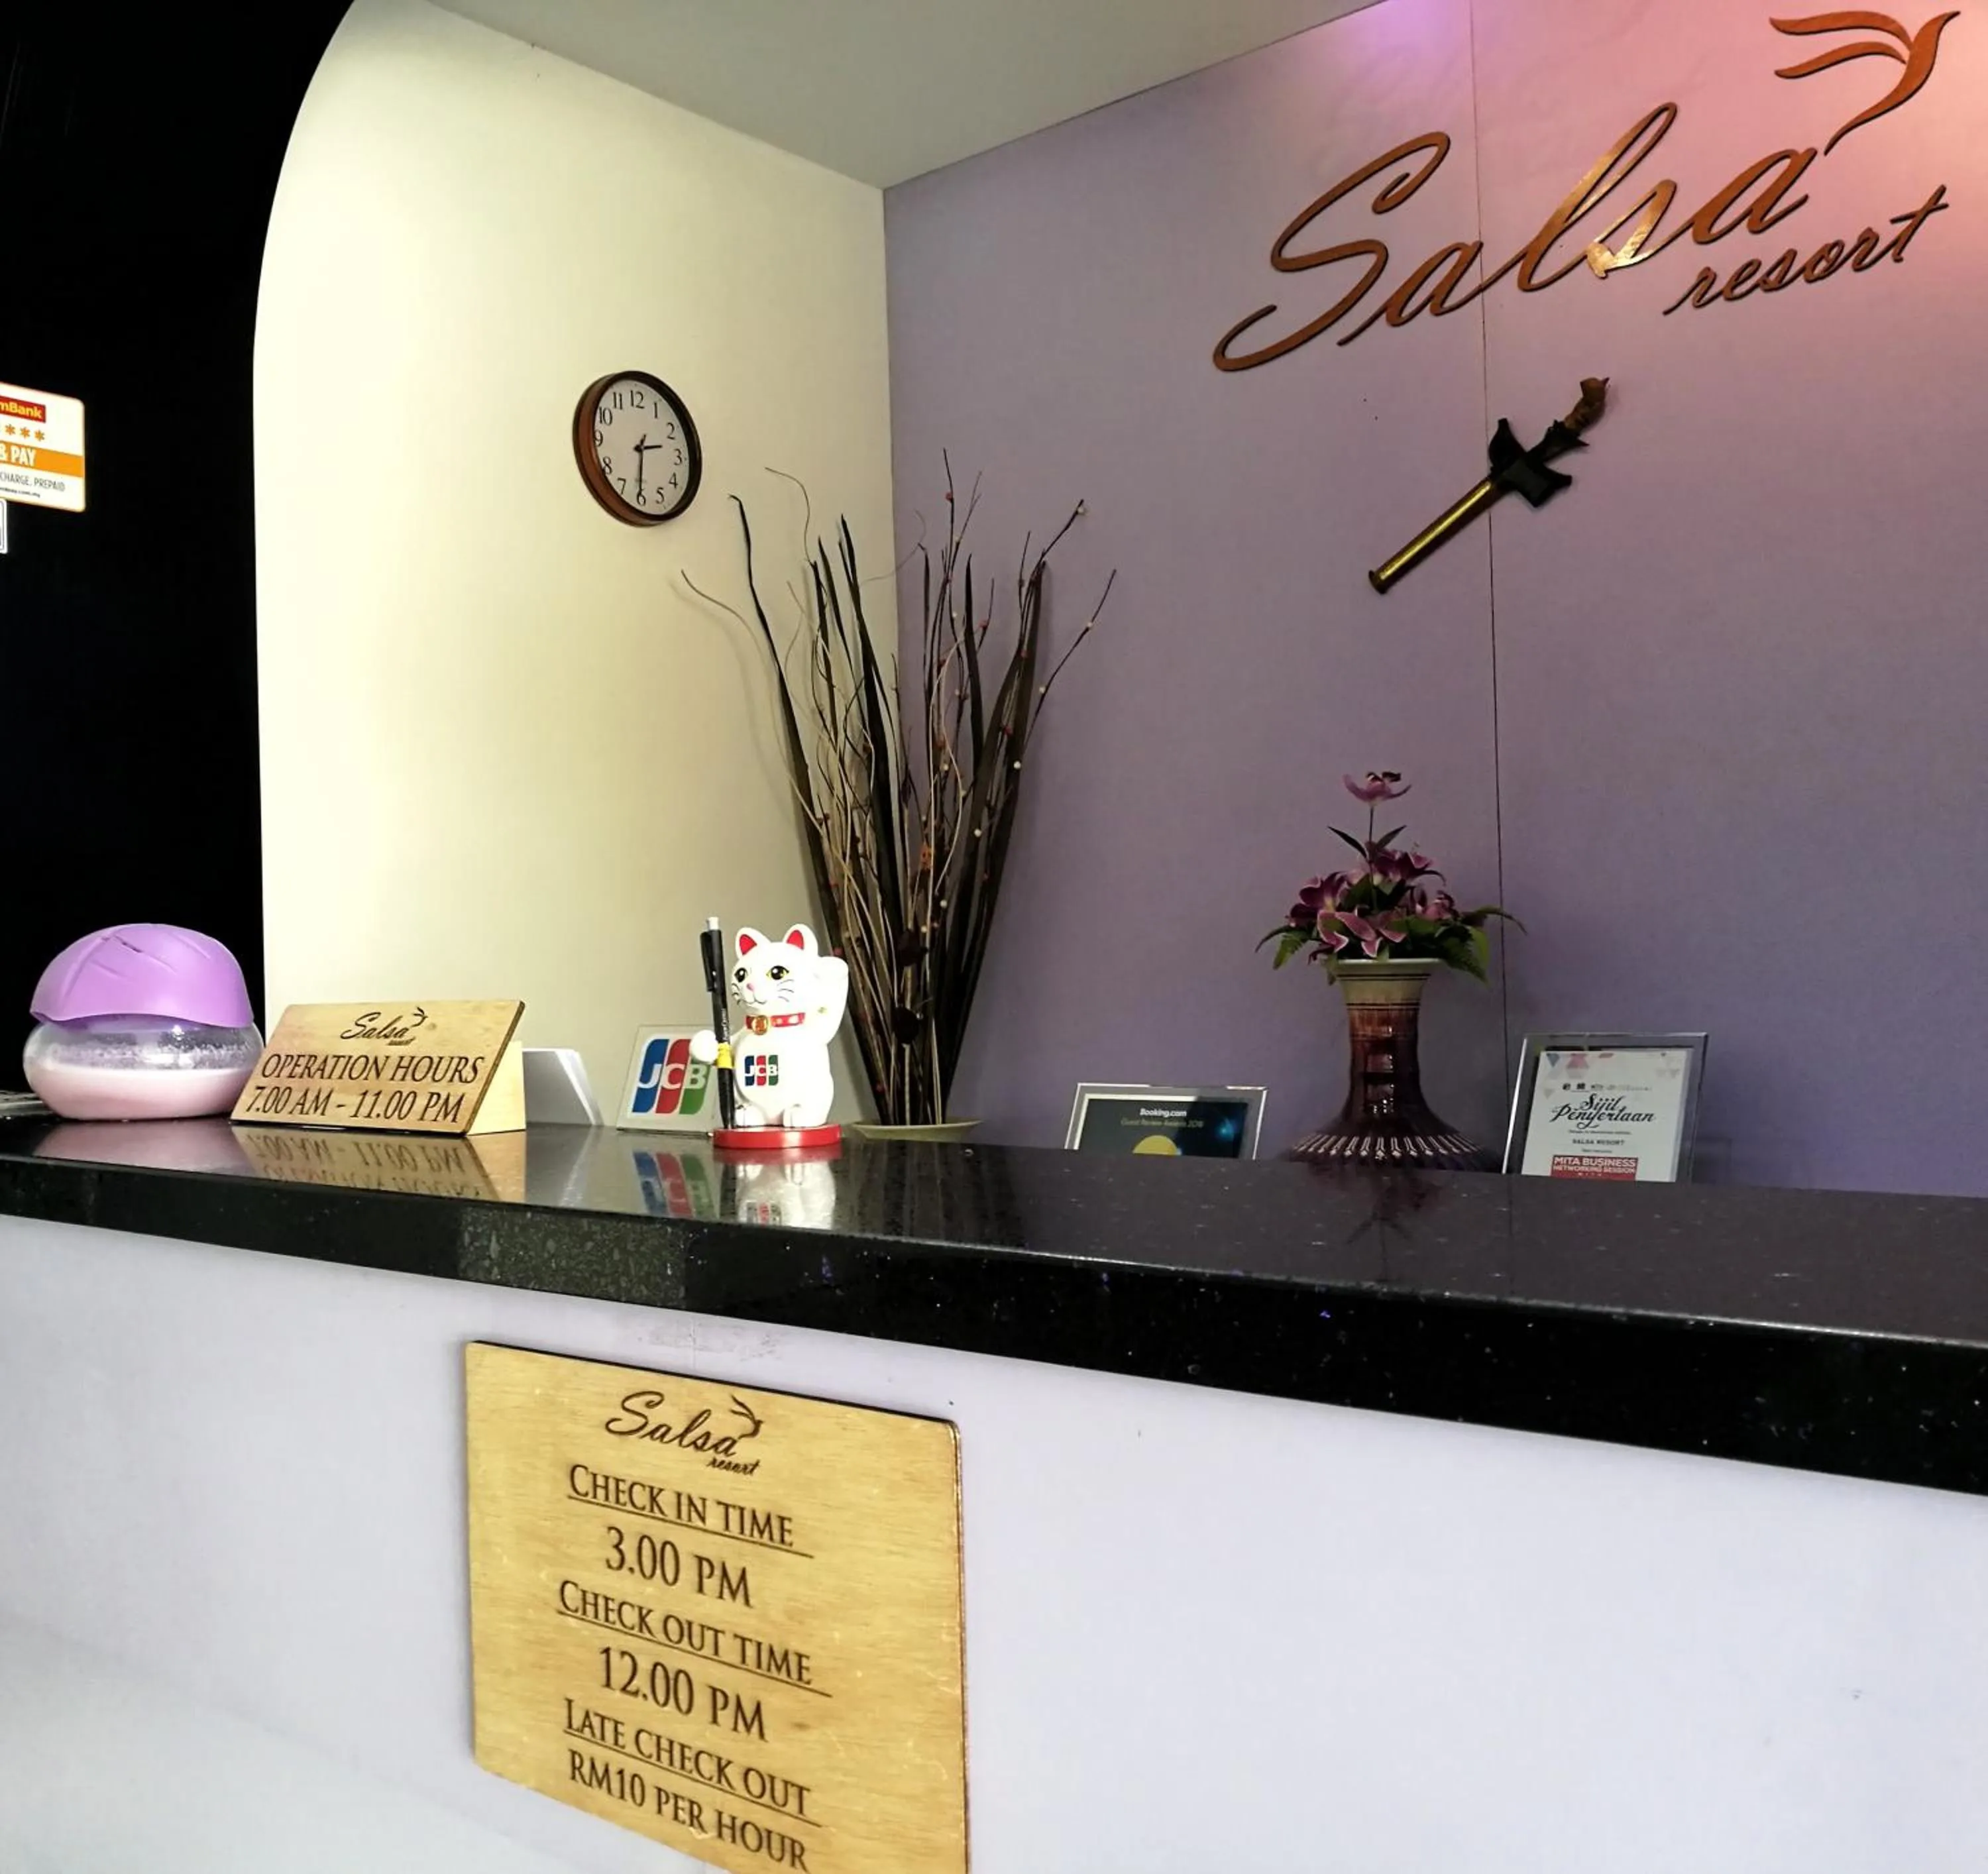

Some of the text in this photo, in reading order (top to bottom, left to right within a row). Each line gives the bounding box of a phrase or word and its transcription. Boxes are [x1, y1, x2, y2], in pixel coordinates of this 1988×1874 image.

[1213, 101, 1817, 372] Salsa
[1663, 184, 1949, 315] resort
[612, 392, 623, 410] 11
[630, 390, 645, 409] 12
[598, 406, 613, 425] 10
[653, 401, 659, 419] 1
[594, 429, 604, 447] 9
[667, 422, 676, 440] 2
[11, 445, 36, 467] PAY
[602, 456, 613, 475] 8
[674, 449, 683, 465] 3
[34, 476, 65, 492] PREPAID
[617, 477, 627, 495] 7
[669, 472, 679, 488] 4
[636, 488, 646, 506] 6
[655, 487, 665, 504] 5
[340, 1011, 410, 1040] Salsa
[261, 1054, 484, 1084] OPERATION HOURS
[246, 1085, 292, 1115] 7.00
[288, 1087, 334, 1117] AM
[349, 1089, 417, 1121] 11.00
[419, 1091, 465, 1123] PM
[1140, 1107, 1187, 1118] Booking.com
[1580, 1093, 1626, 1114] Sijil
[1549, 1103, 1655, 1129] Penyertaan
[1554, 1156, 1636, 1168] MITA BUSINESS
[605, 1390, 738, 1458] Salsa
[569, 1464, 794, 1549] CHECK IN TIME
[606, 1526, 751, 1609] 3.00 PM
[559, 1579, 813, 1686] CHECK OUT TIME
[598, 1646, 769, 1743] 12.00 PM
[563, 1698, 811, 1817] LATE CHECK OUT
[568, 1749, 809, 1873] RM10 PER HOUR
